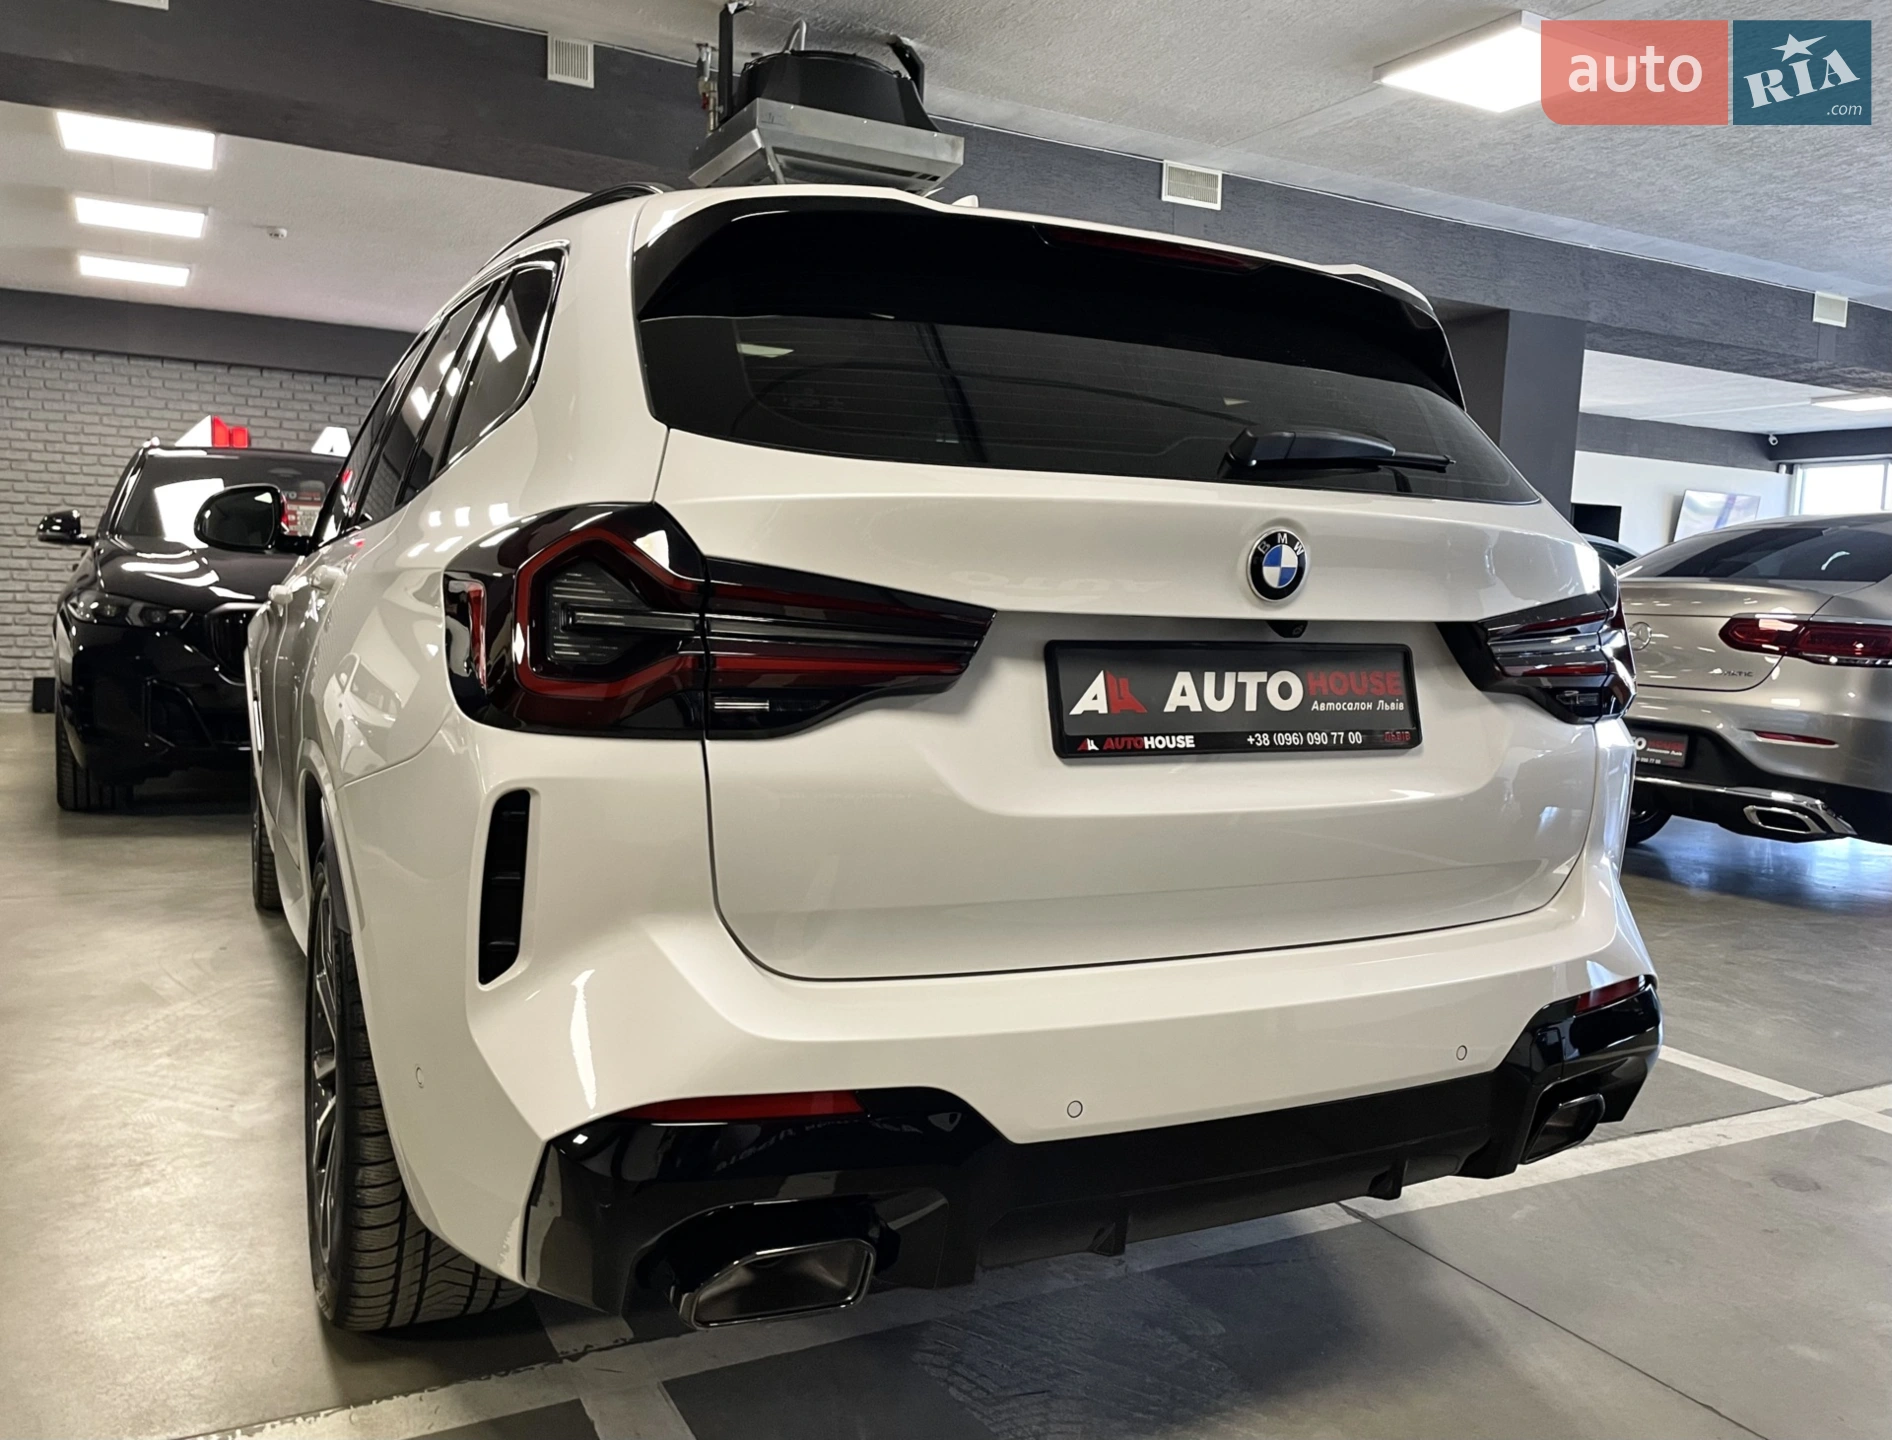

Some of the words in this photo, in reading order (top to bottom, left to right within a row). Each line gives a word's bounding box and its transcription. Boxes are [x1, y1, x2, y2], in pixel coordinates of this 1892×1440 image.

[1257, 532, 1305, 556] BMW
[1163, 670, 1304, 713] AUTO
[1306, 669, 1404, 696] HOUSE
[1311, 699, 1373, 712] Автосалон
[1376, 698, 1405, 711] Львів
[1102, 735, 1196, 751] AUTOHOUSE
[1246, 732, 1270, 746] +38
[1273, 732, 1304, 746] (096)
[1306, 731, 1329, 745] 090
[1330, 731, 1345, 744] 77
[1348, 731, 1363, 744] 00
